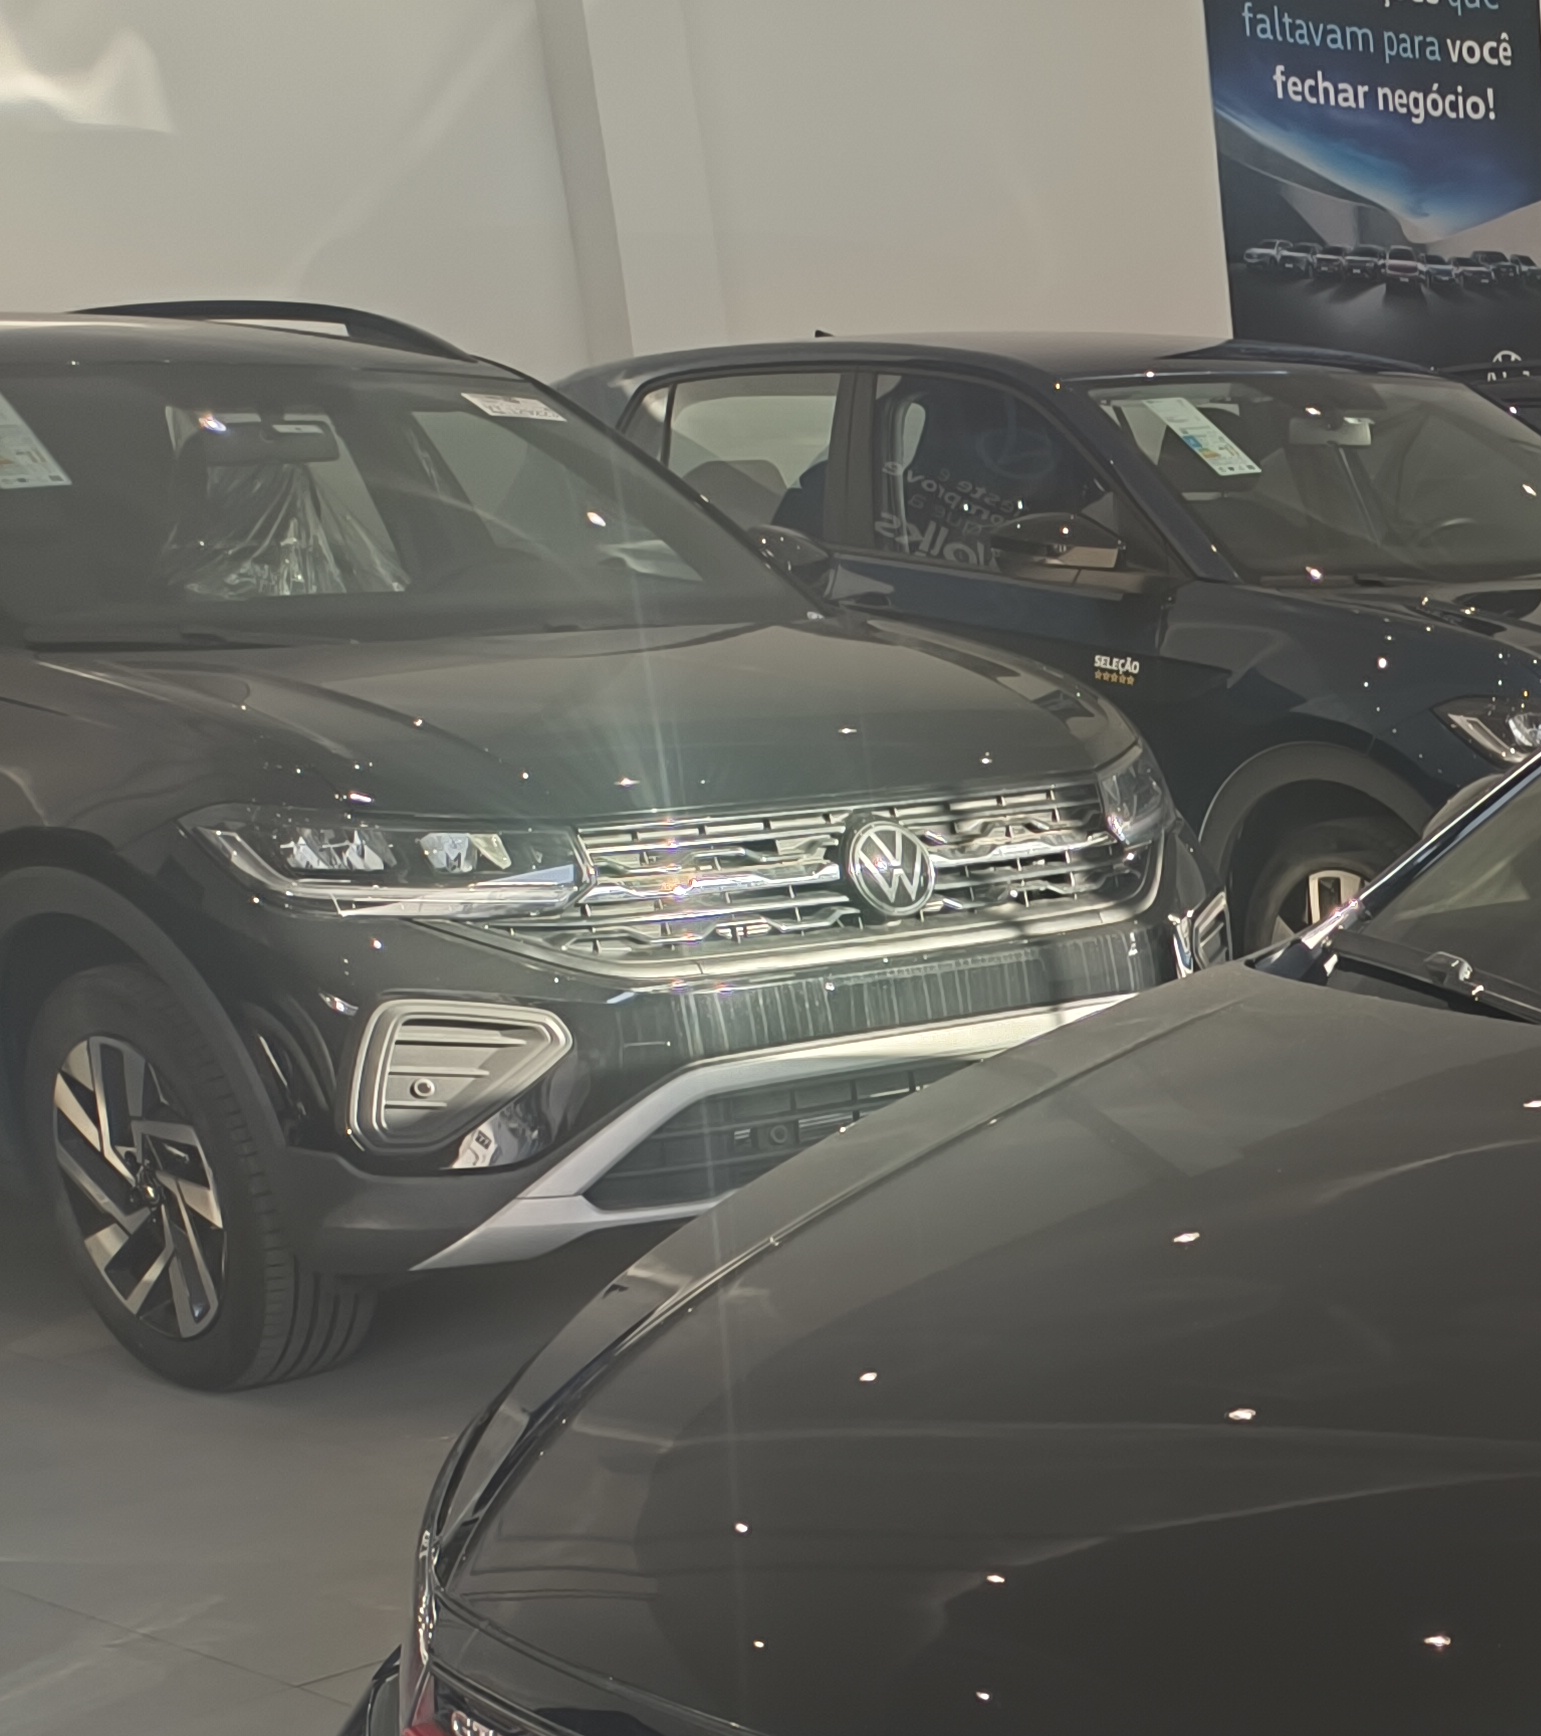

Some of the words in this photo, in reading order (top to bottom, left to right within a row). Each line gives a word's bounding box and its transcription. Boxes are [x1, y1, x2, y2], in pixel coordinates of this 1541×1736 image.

[1241, 1, 1374, 53] faltavam
[1383, 30, 1441, 64] para
[1446, 32, 1512, 66] você
[1272, 65, 1369, 111] fechar
[1376, 82, 1496, 124] negócio!
[1094, 654, 1140, 674] SELEÇÃO
